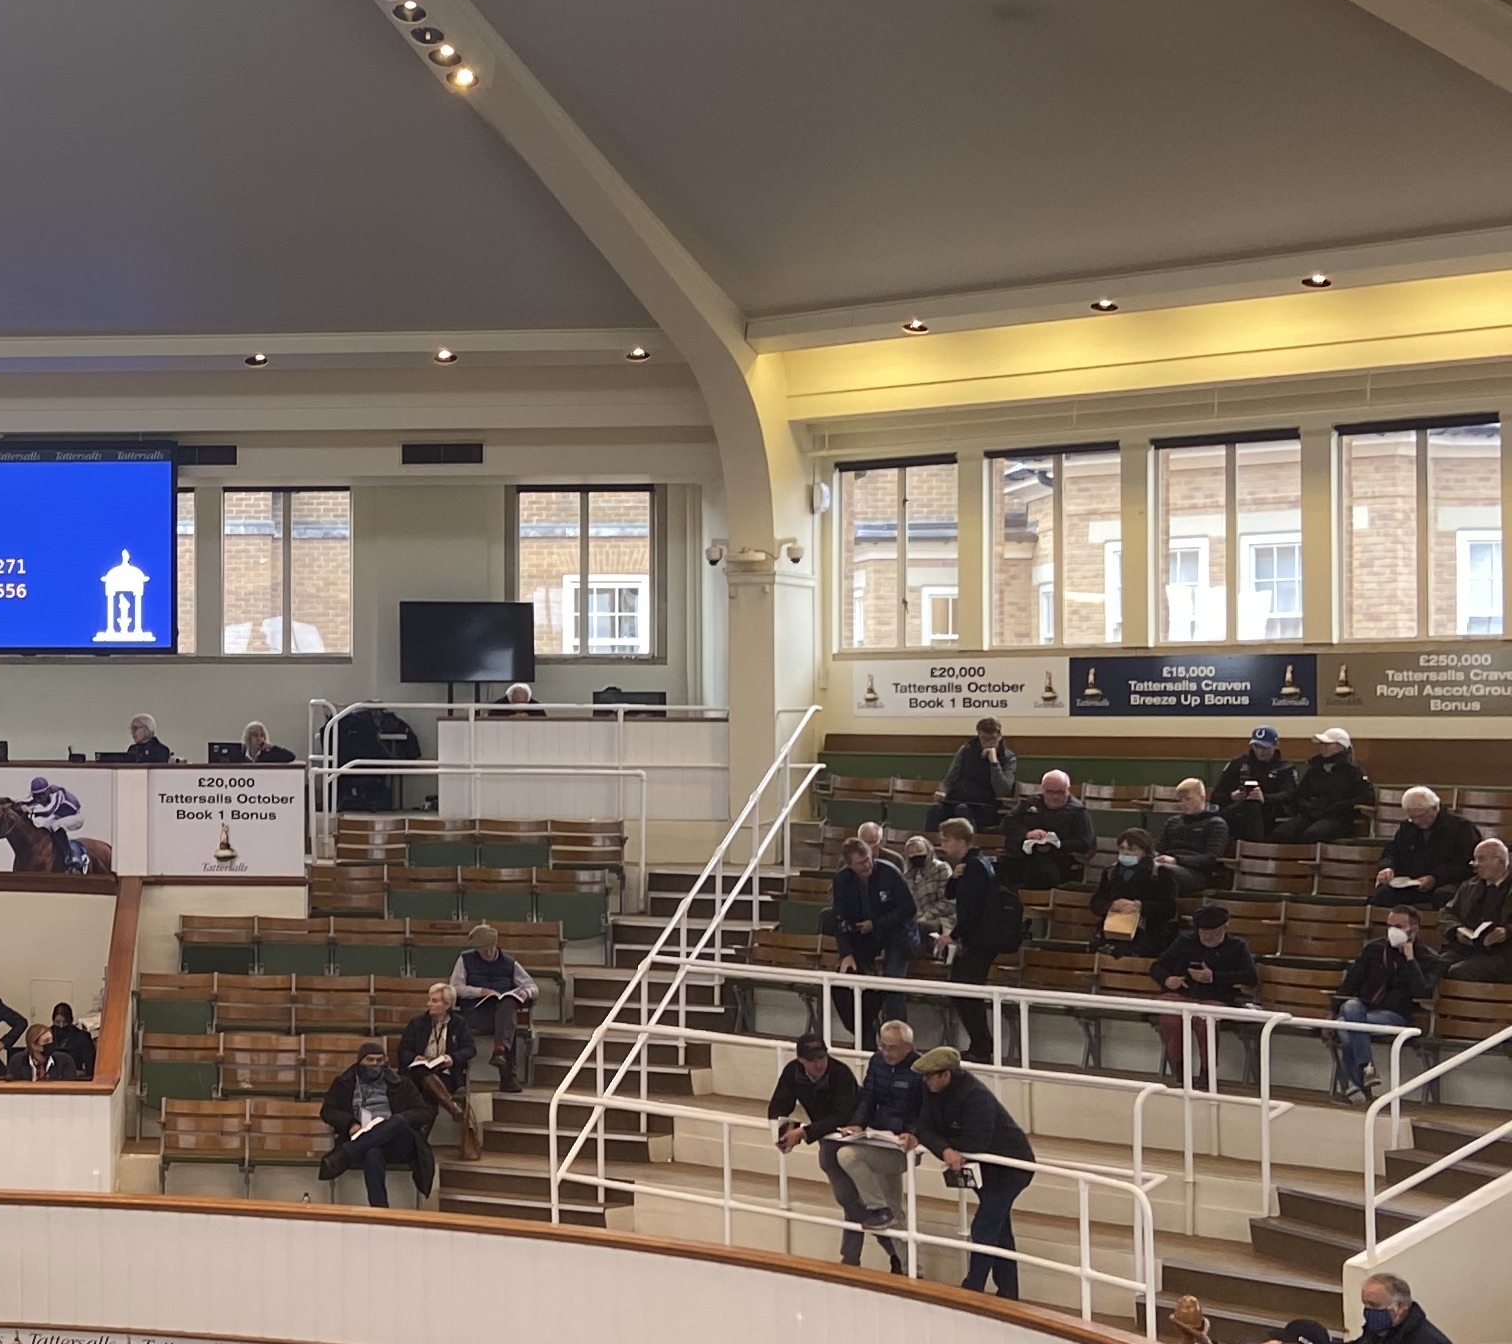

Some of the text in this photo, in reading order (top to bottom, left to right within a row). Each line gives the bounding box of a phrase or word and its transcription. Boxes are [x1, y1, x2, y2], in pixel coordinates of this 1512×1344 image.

[1419, 654, 1492, 668] £250,000
[930, 666, 986, 679] £20,000
[1162, 666, 1216, 678] £15,000
[1385, 669, 1512, 682] Tattersalls Crave
[892, 682, 1025, 693] Tattersalls October
[1128, 679, 1251, 691] Tattersalls Craven
[1376, 683, 1512, 699] Royal Ascot/Grou
[909, 697, 1008, 709] Book 1 Bonus
[1130, 694, 1250, 707] Breeze Up Bonus
[1430, 699, 1481, 711] Bonus
[198, 777, 255, 789] £20,000
[158, 793, 295, 805] Tattersalls October
[176, 809, 277, 821] Book 1 Bonus
